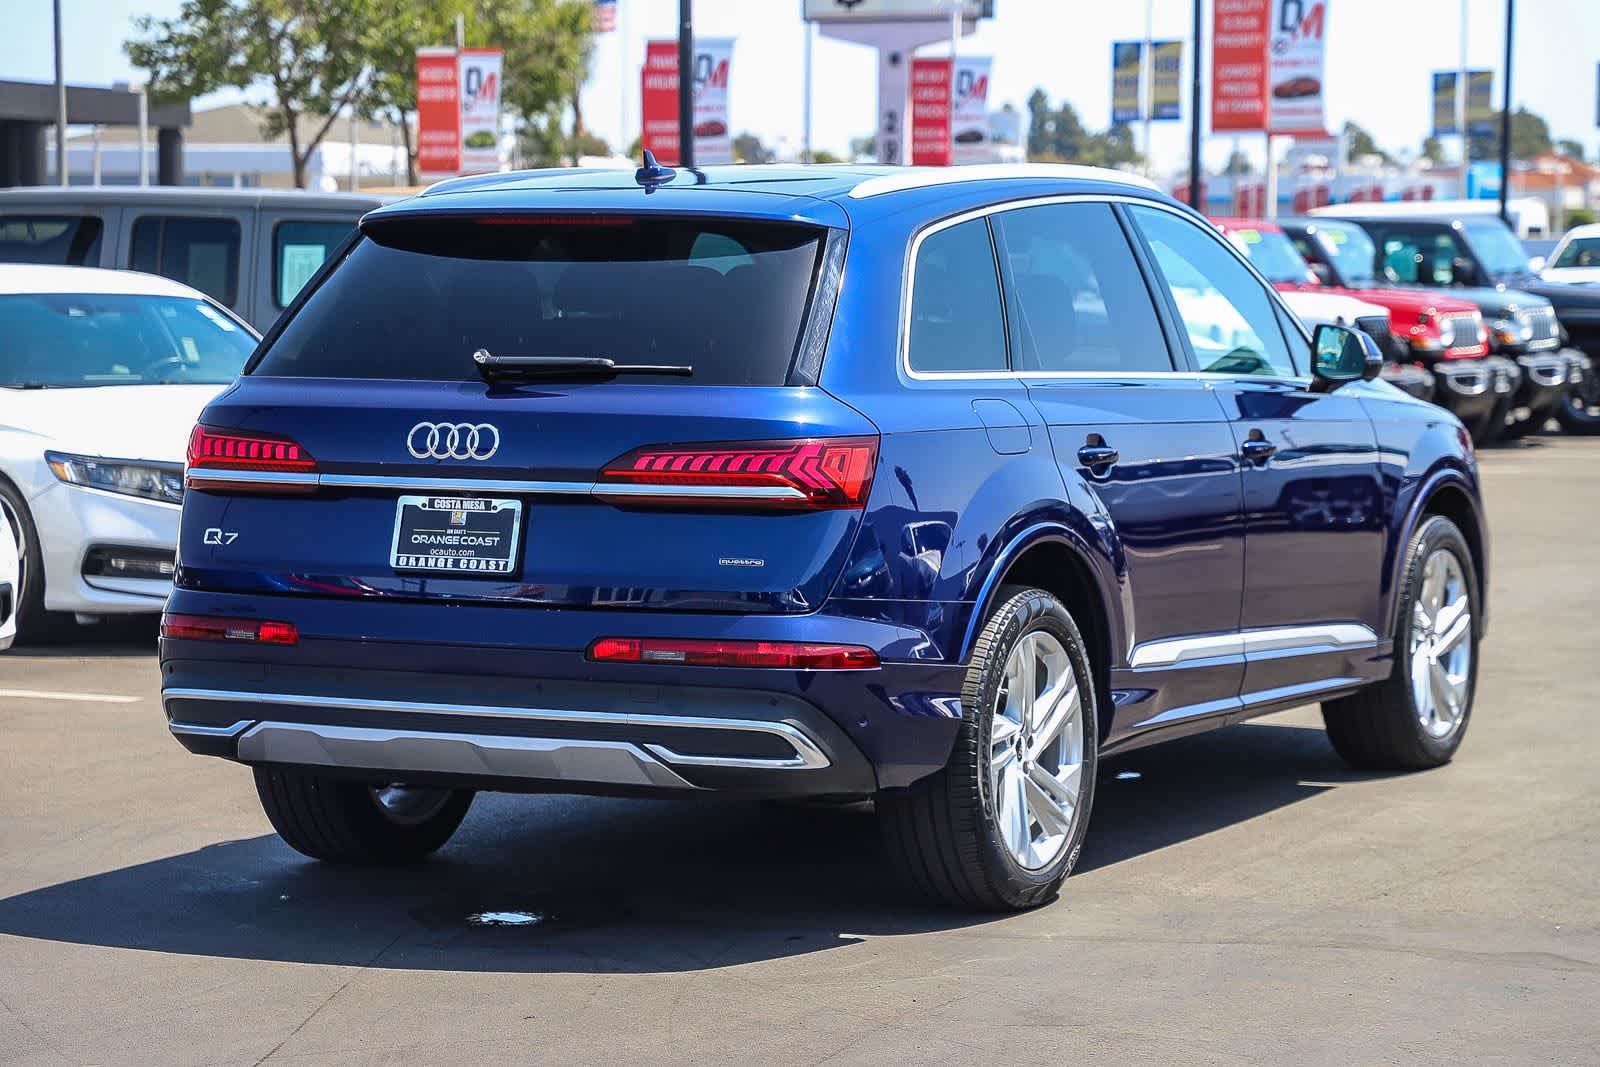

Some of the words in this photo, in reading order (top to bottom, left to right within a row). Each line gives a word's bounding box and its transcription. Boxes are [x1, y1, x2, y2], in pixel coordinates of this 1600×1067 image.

[434, 499, 461, 509] COSTA
[462, 500, 486, 511] MESA
[203, 527, 239, 545] Q7
[429, 548, 475, 557] ocauto.com
[398, 556, 454, 569] ORANGE
[459, 559, 507, 571] COAST
